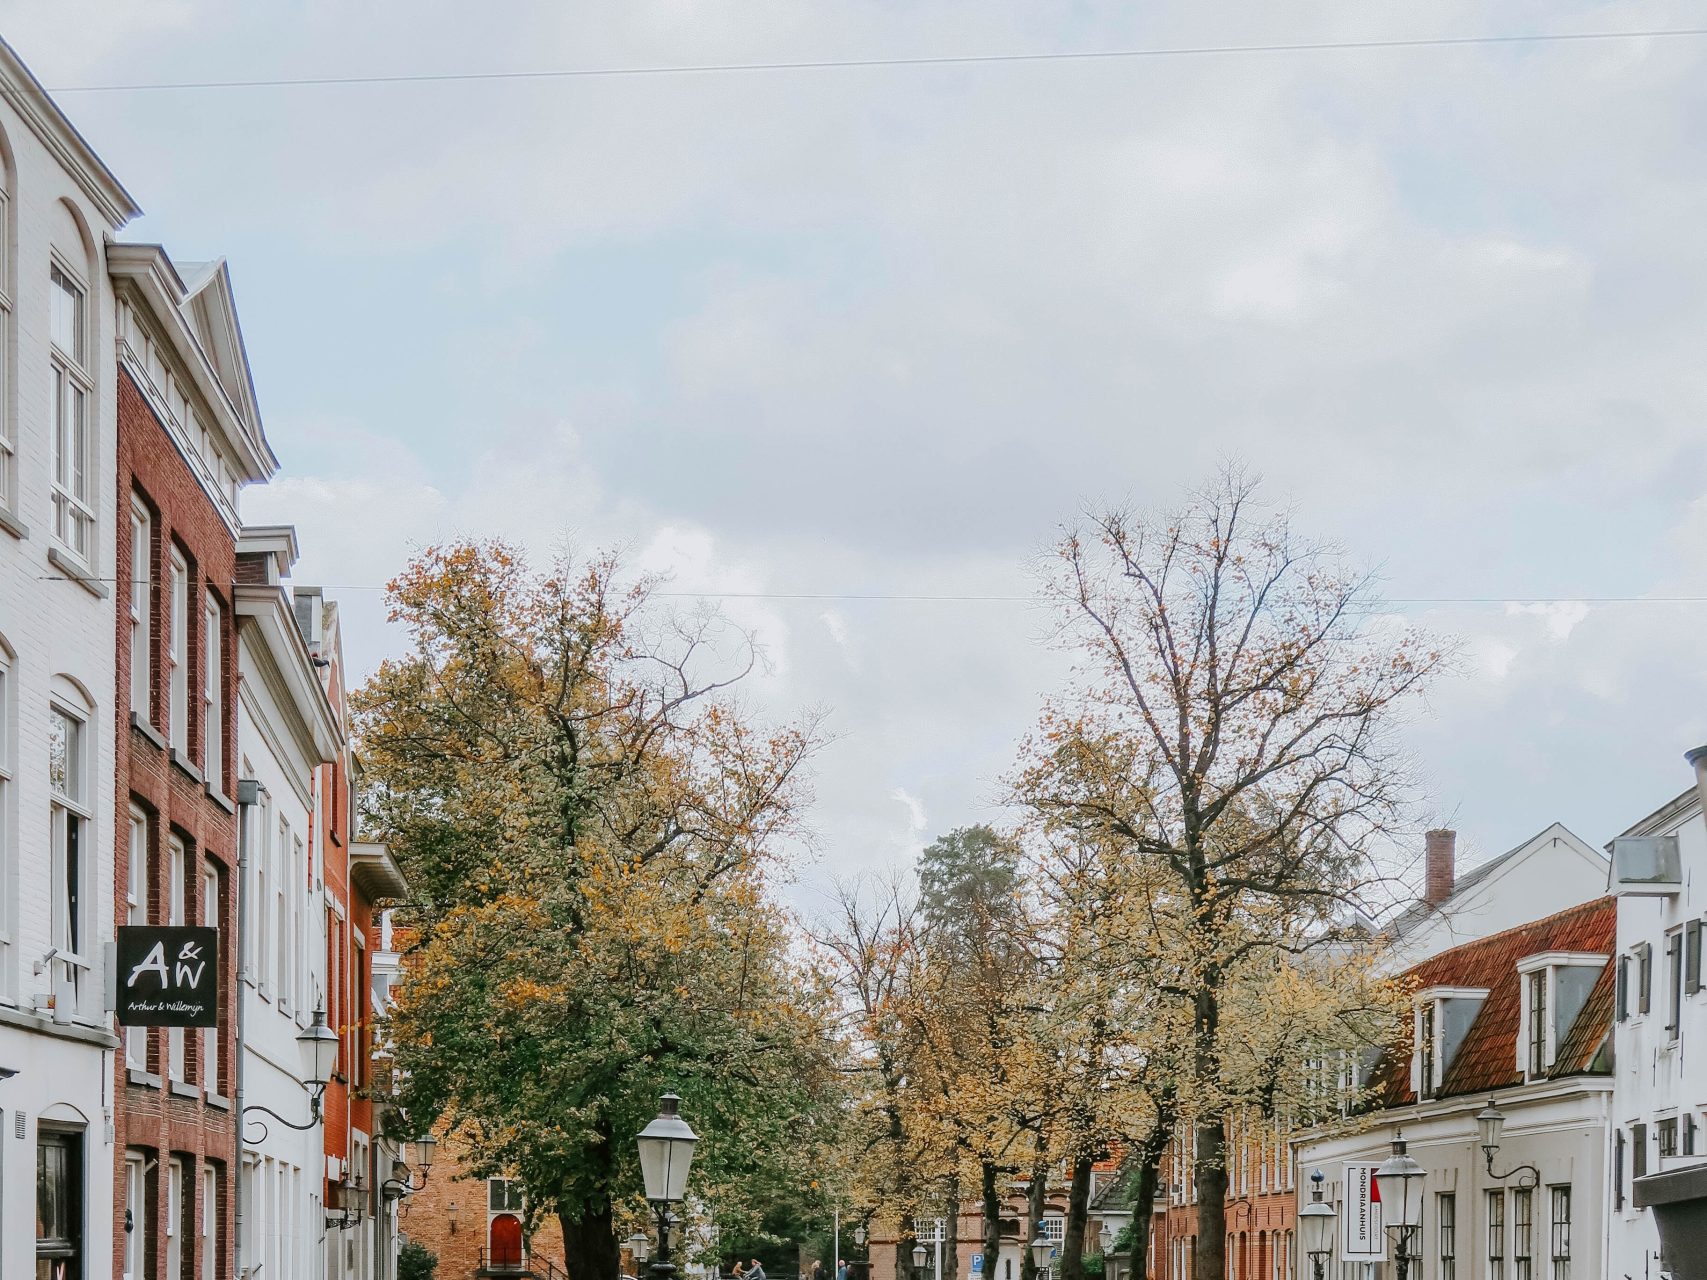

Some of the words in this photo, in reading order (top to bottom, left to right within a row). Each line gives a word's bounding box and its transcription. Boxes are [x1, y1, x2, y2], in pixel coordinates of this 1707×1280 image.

[178, 941, 203, 960] &
[127, 940, 169, 989] A
[175, 960, 206, 990] W
[127, 999, 158, 1011] Arthur
[157, 1001, 165, 1011] &
[1359, 1167, 1367, 1241] MONDRIAANHUIS
[973, 1255, 981, 1265] P
